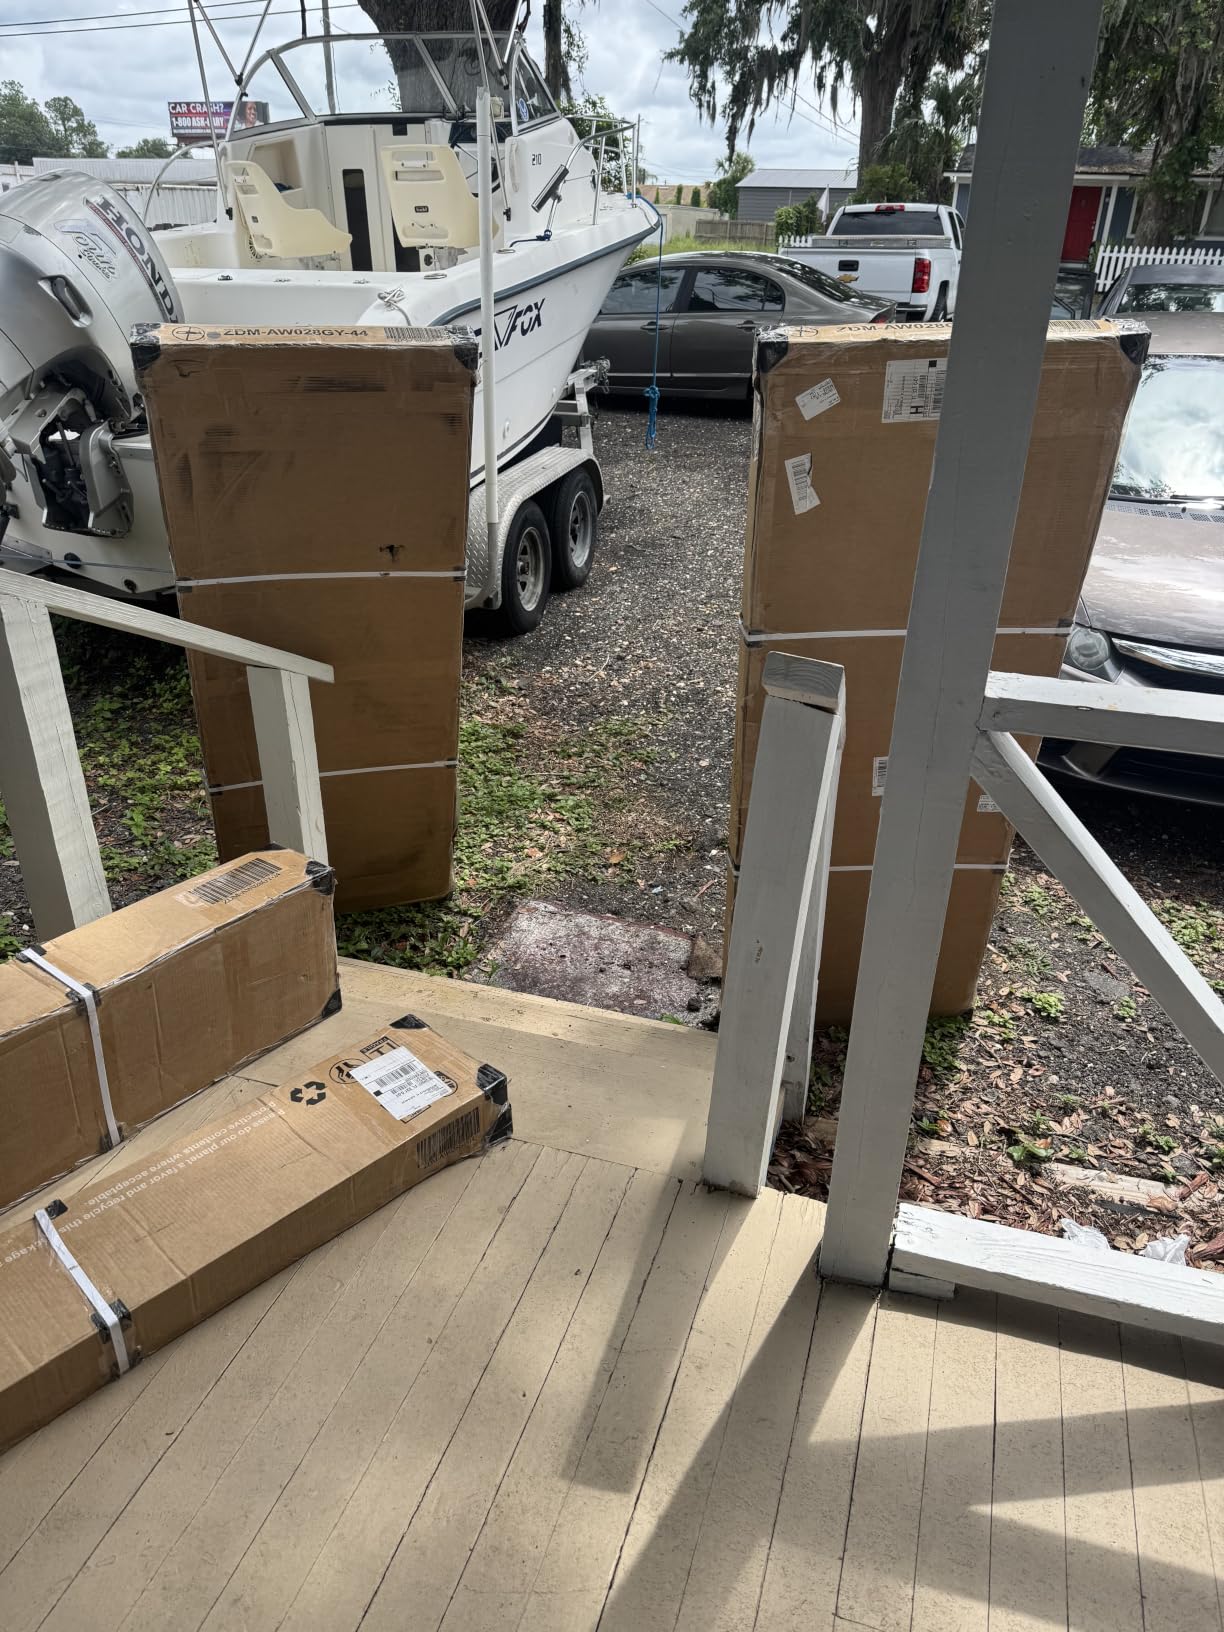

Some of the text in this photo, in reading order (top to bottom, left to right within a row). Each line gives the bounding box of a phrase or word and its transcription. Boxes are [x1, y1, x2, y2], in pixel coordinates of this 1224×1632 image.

[170, 103, 188, 113] CAR
[172, 116, 191, 127] 1-800
[532, 153, 542, 165] 210
[97, 195, 179, 323] HOND
[504, 298, 545, 347] FOX
[223, 328, 368, 337] ZDM-AW028GY-44
[252, 1109, 285, 1128] Pease
[238, 1126, 251, 1136] do
[220, 1134, 237, 1146] our
[84, 1101, 276, 1206] potective contents where acceptable.
[185, 1142, 219, 1165] planet
[149, 1166, 178, 1185] favor
[126, 1182, 148, 1198] and
[83, 1194, 126, 1220] recycle
[58, 1218, 82, 1234] this
[4, 1237, 48, 1263] ckage
